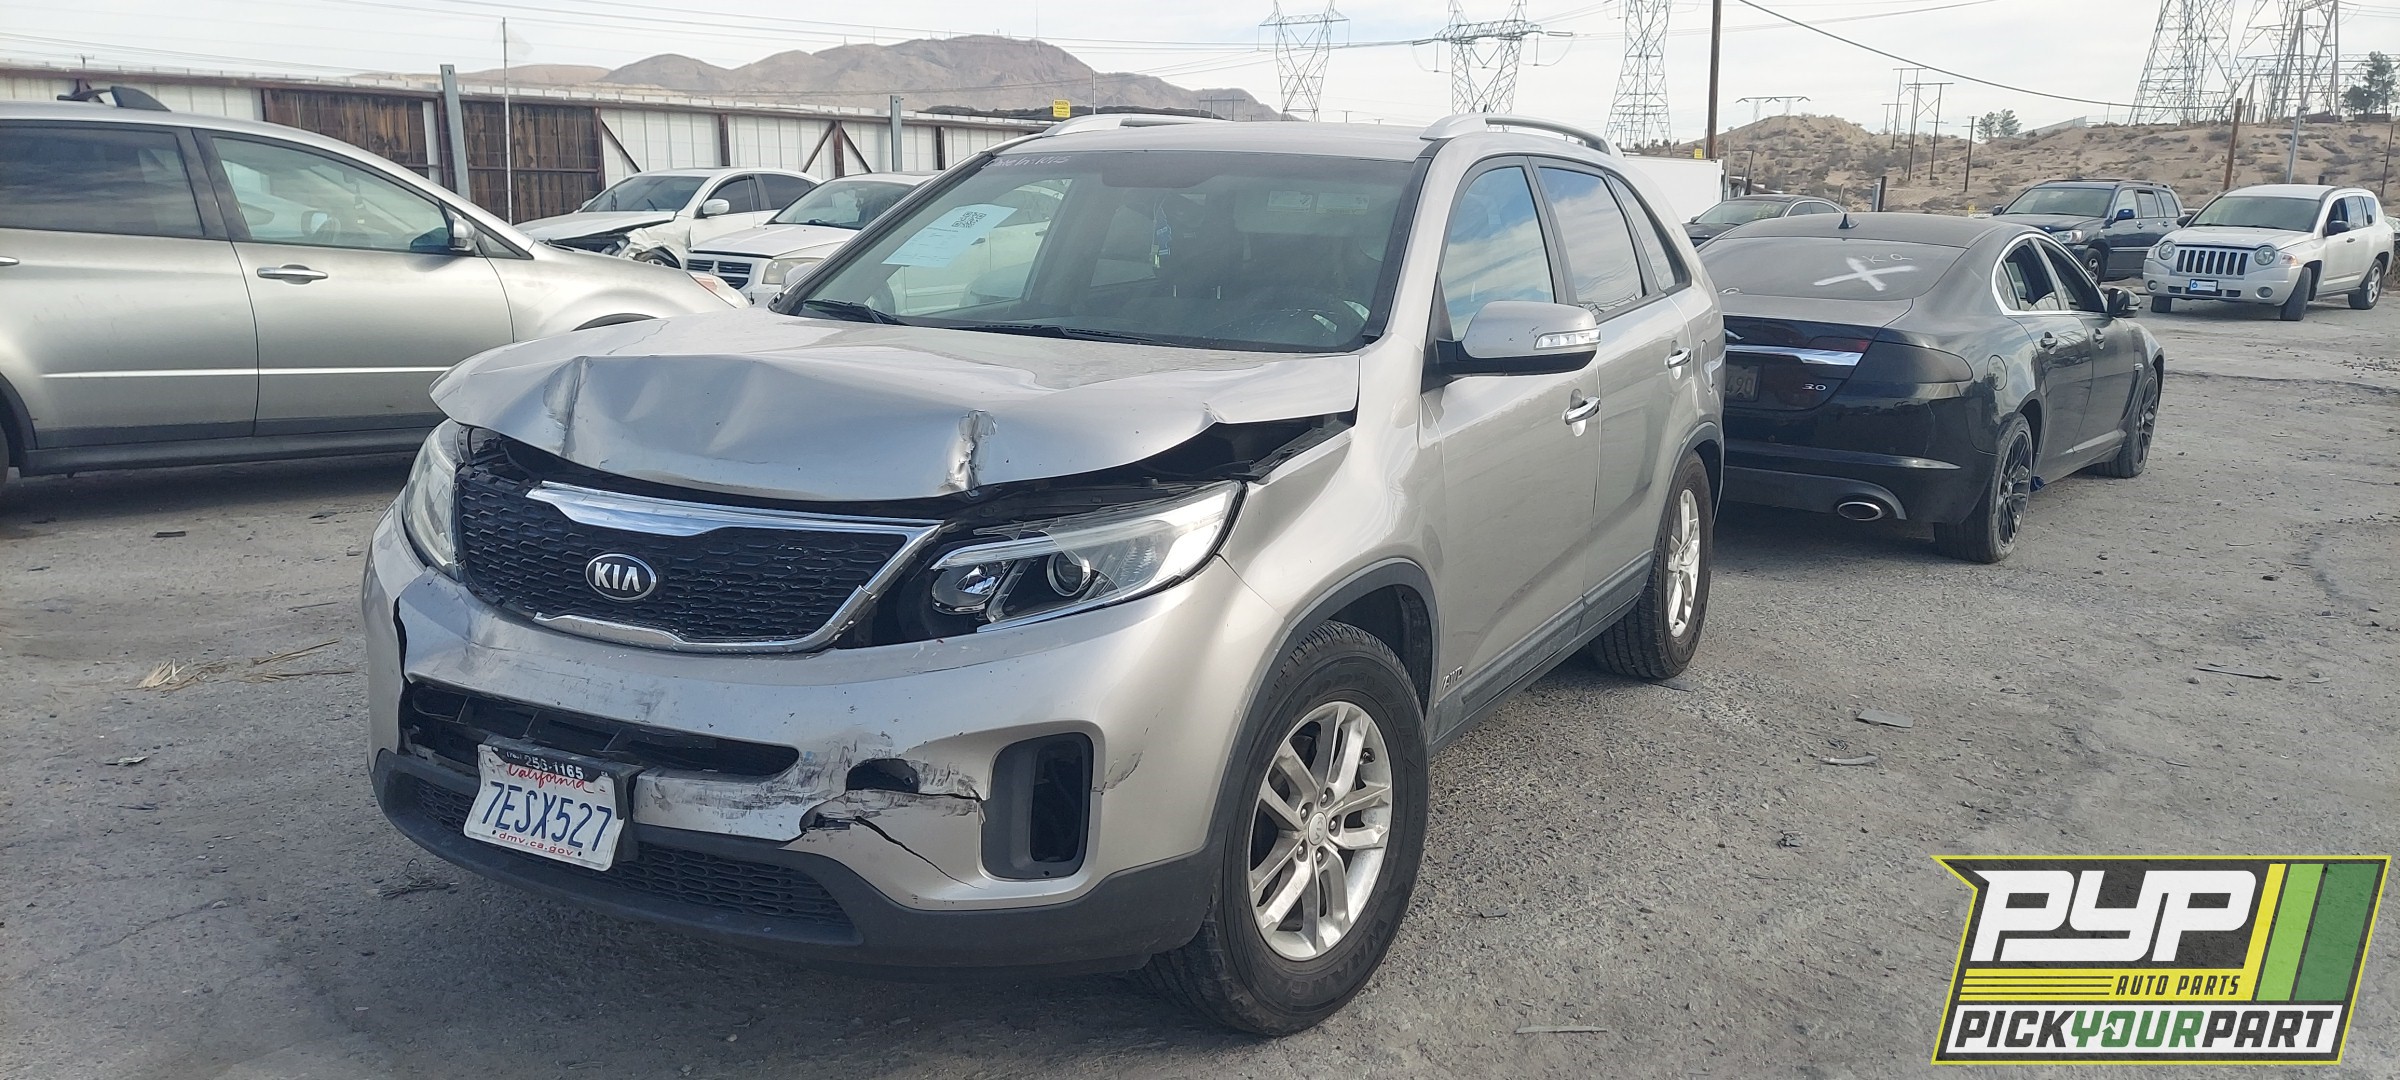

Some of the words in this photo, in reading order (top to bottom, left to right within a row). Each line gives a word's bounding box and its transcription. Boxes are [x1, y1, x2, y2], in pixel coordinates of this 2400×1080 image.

[594, 562, 642, 592] KIA
[506, 763, 595, 793] California
[482, 781, 612, 851] 7ESX527
[498, 832, 575, 857] dmv.ca.gov
